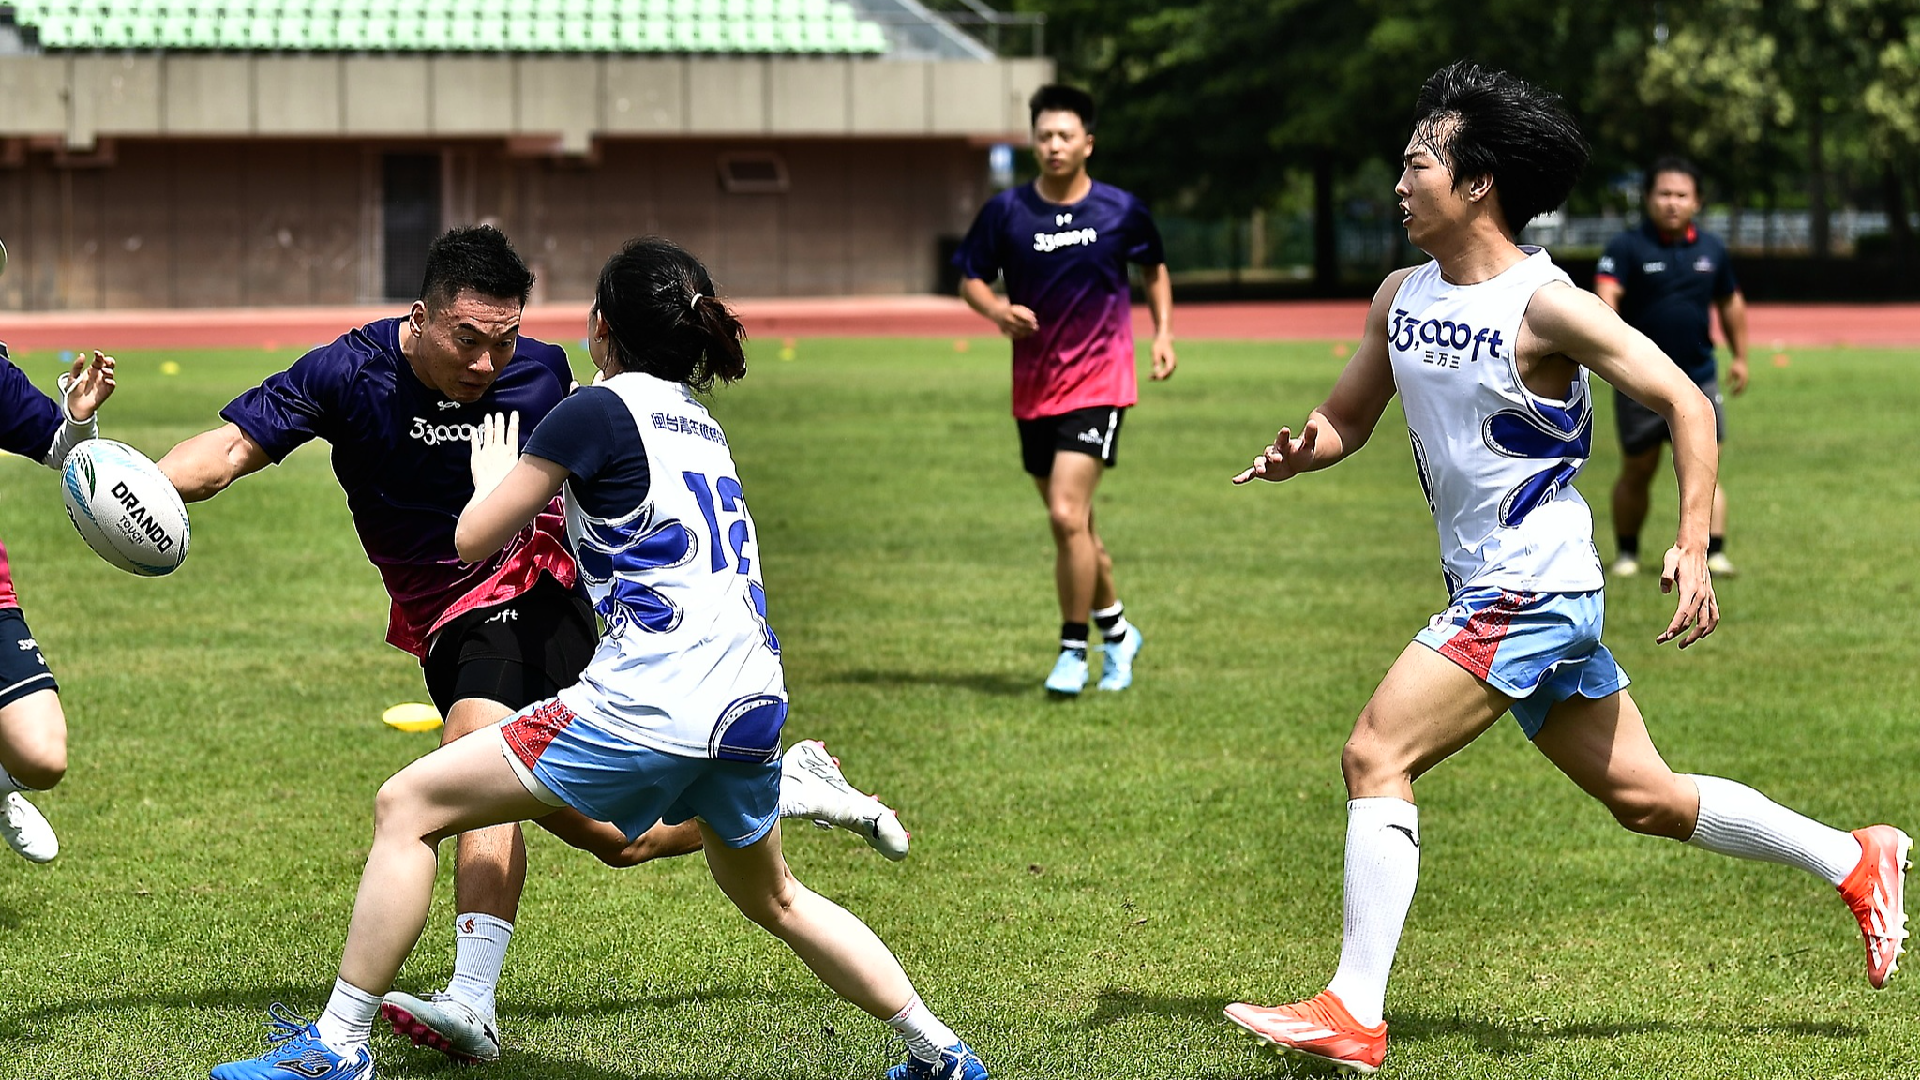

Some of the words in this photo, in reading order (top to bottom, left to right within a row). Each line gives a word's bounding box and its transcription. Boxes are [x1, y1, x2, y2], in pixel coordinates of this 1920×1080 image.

[1423, 350, 1460, 369] 三万三
[111, 481, 174, 554] DRANDO
[119, 515, 145, 545] TOUCH
